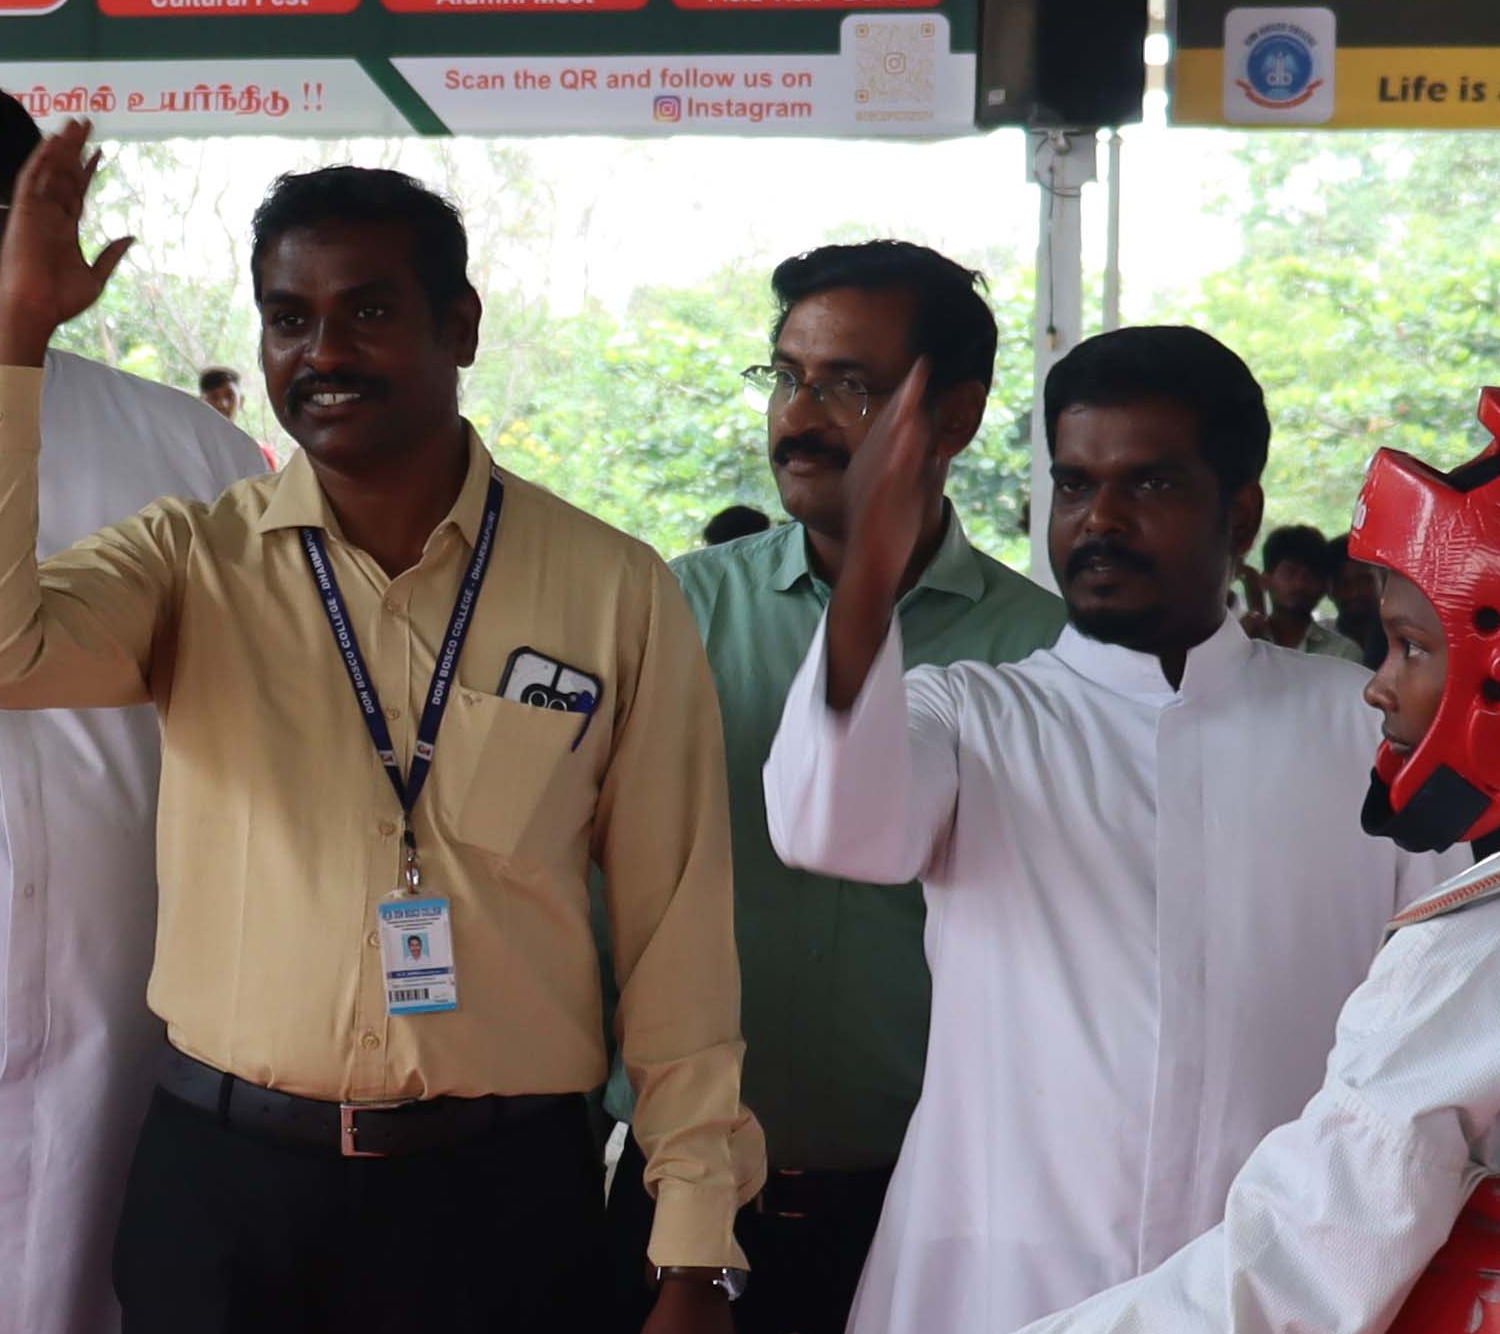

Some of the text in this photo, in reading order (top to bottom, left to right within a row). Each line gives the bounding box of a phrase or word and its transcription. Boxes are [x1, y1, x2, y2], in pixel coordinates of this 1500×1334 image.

[445, 67, 812, 90] Scan the QR and follow us on
[1378, 74, 1448, 103] Life
[1459, 75, 1486, 102] is
[687, 97, 812, 123] Instagram
[327, 597, 351, 649] COLLEGE
[452, 588, 474, 638] COLLEGE
